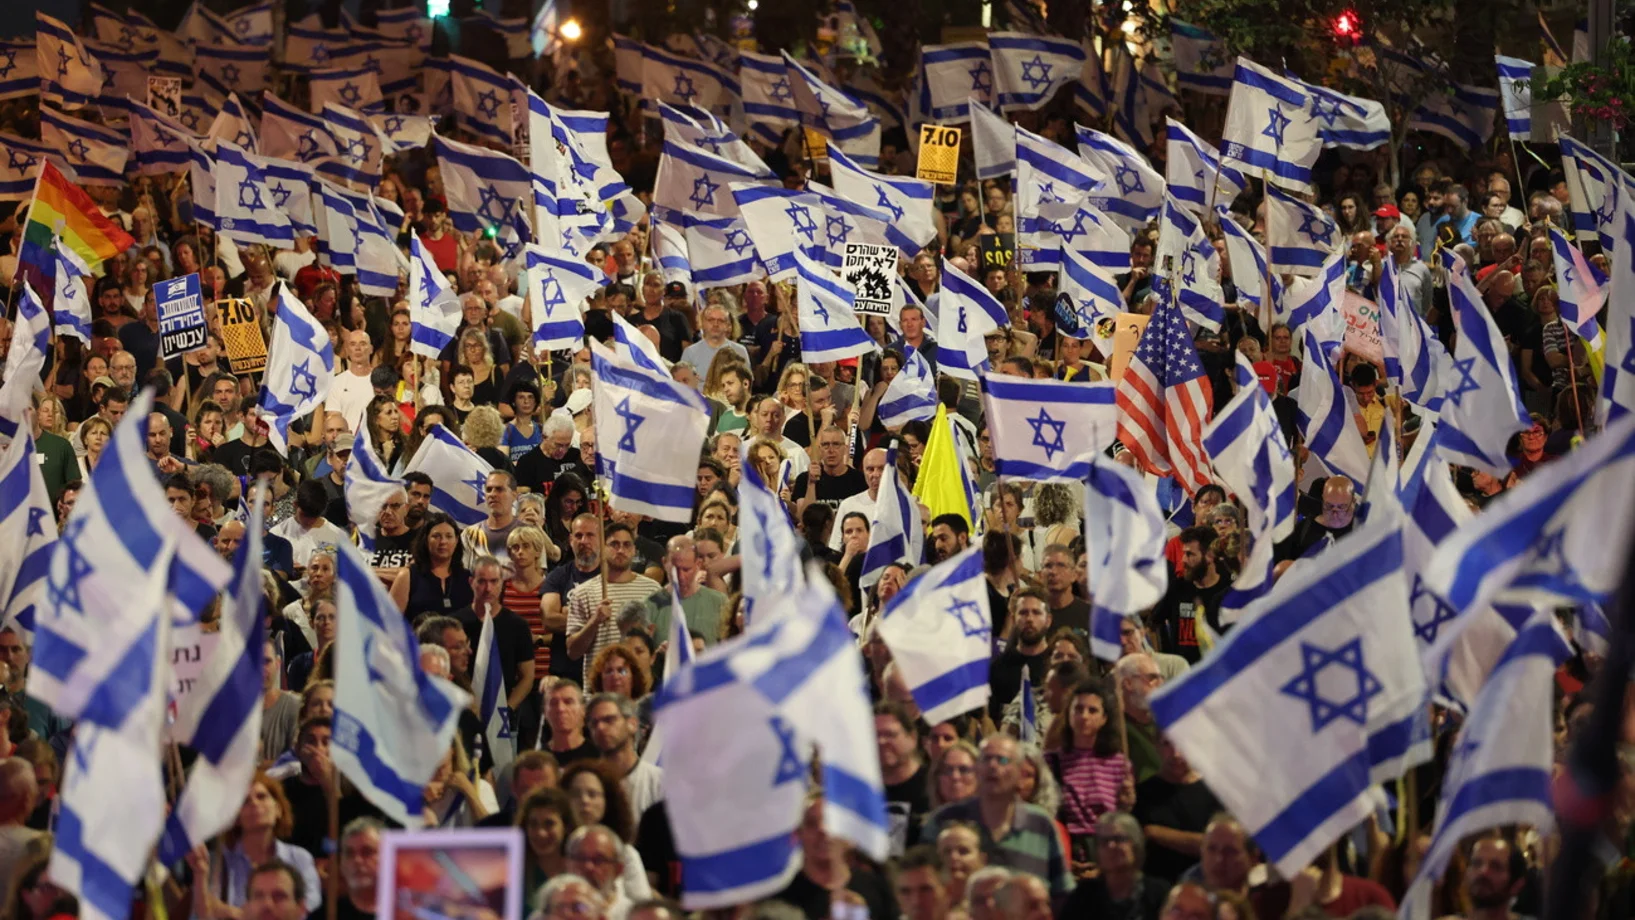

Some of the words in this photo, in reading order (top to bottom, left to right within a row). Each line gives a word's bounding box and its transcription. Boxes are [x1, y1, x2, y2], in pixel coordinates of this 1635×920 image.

[923, 127, 959, 147] 7.10
[846, 244, 880, 256] שהרס
[881, 247, 897, 259] מי
[873, 257, 895, 269] לא
[161, 311, 204, 333] בחירות
[217, 300, 255, 326] 7.10
[163, 327, 204, 353] עכשיו!
